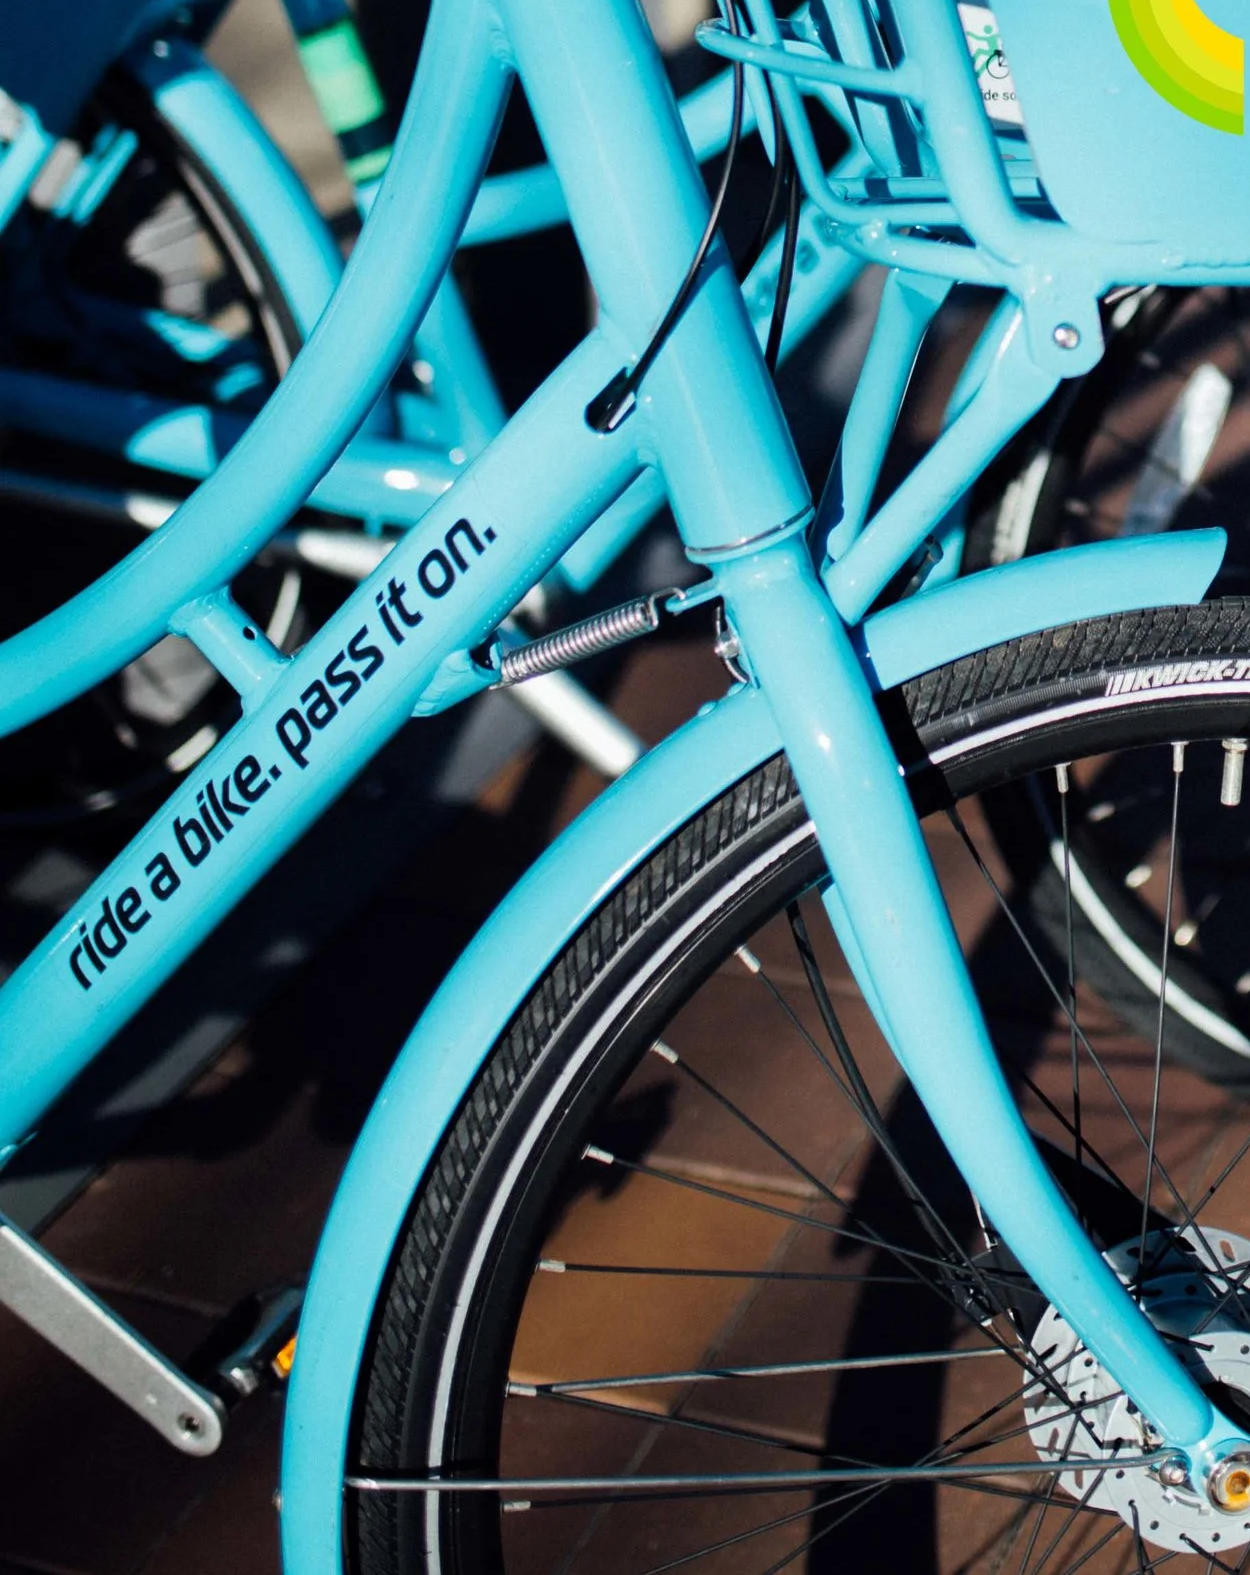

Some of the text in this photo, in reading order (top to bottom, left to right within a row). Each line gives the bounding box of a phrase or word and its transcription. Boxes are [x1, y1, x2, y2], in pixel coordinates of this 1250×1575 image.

[69, 517, 498, 990] ride a bike. pass it on.
